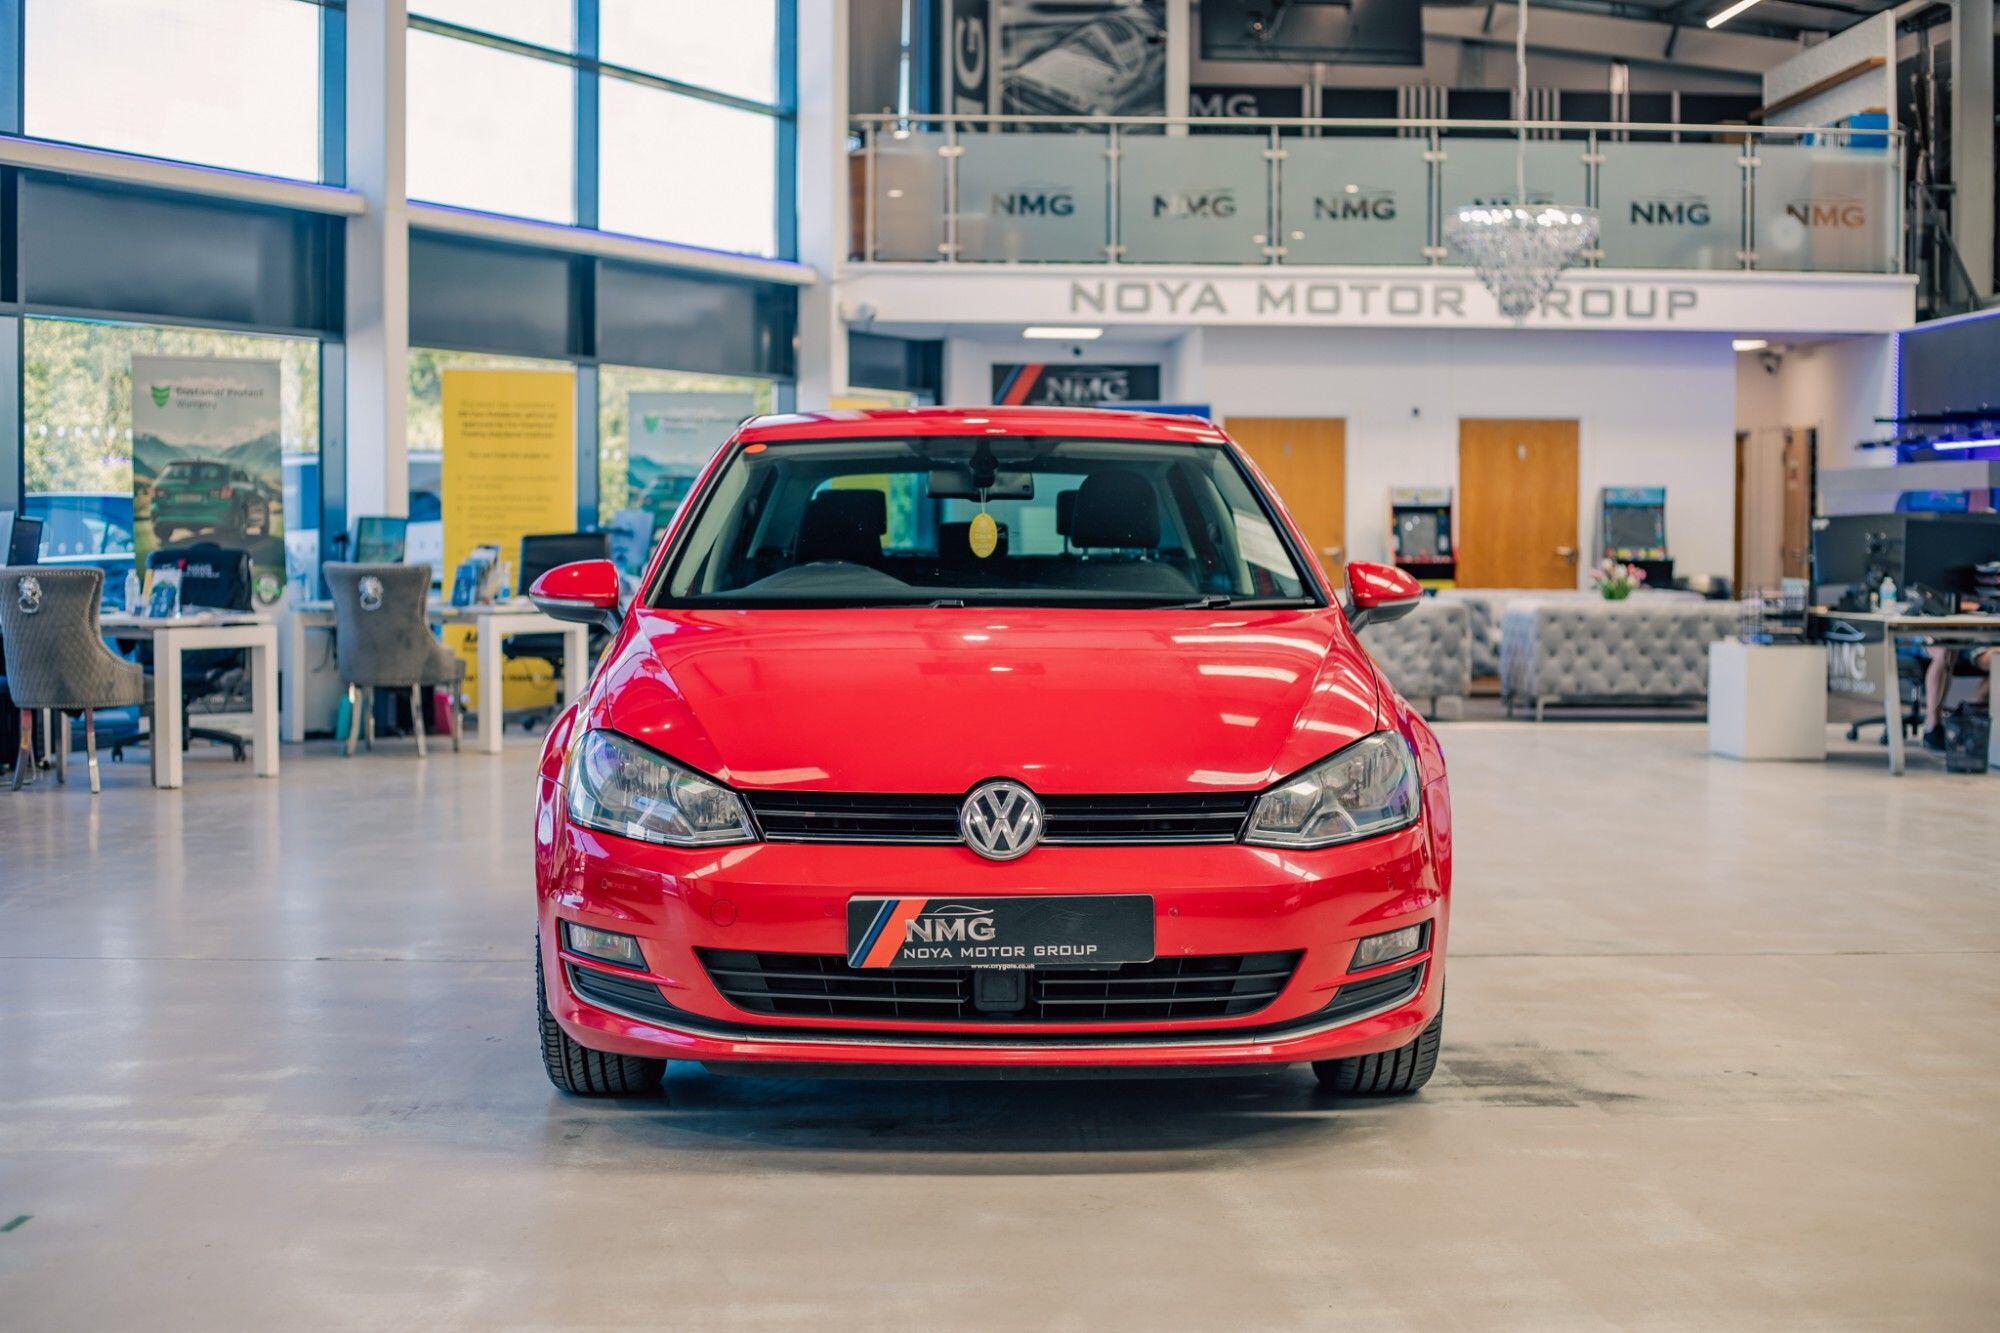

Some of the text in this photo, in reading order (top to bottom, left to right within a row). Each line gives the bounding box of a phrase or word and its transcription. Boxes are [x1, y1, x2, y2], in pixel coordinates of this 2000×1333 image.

[991, 194, 1075, 216] NMG
[1313, 197, 1397, 220] NMG
[1630, 201, 1711, 226] NMG
[1786, 203, 1866, 227] NMG
[1070, 282, 1698, 319] NOYA MOTOR ROUP
[1045, 376, 1130, 401] NMG
[905, 917, 996, 943] NMG
[903, 944, 1098, 959] NOYA MOTOR GROUP
